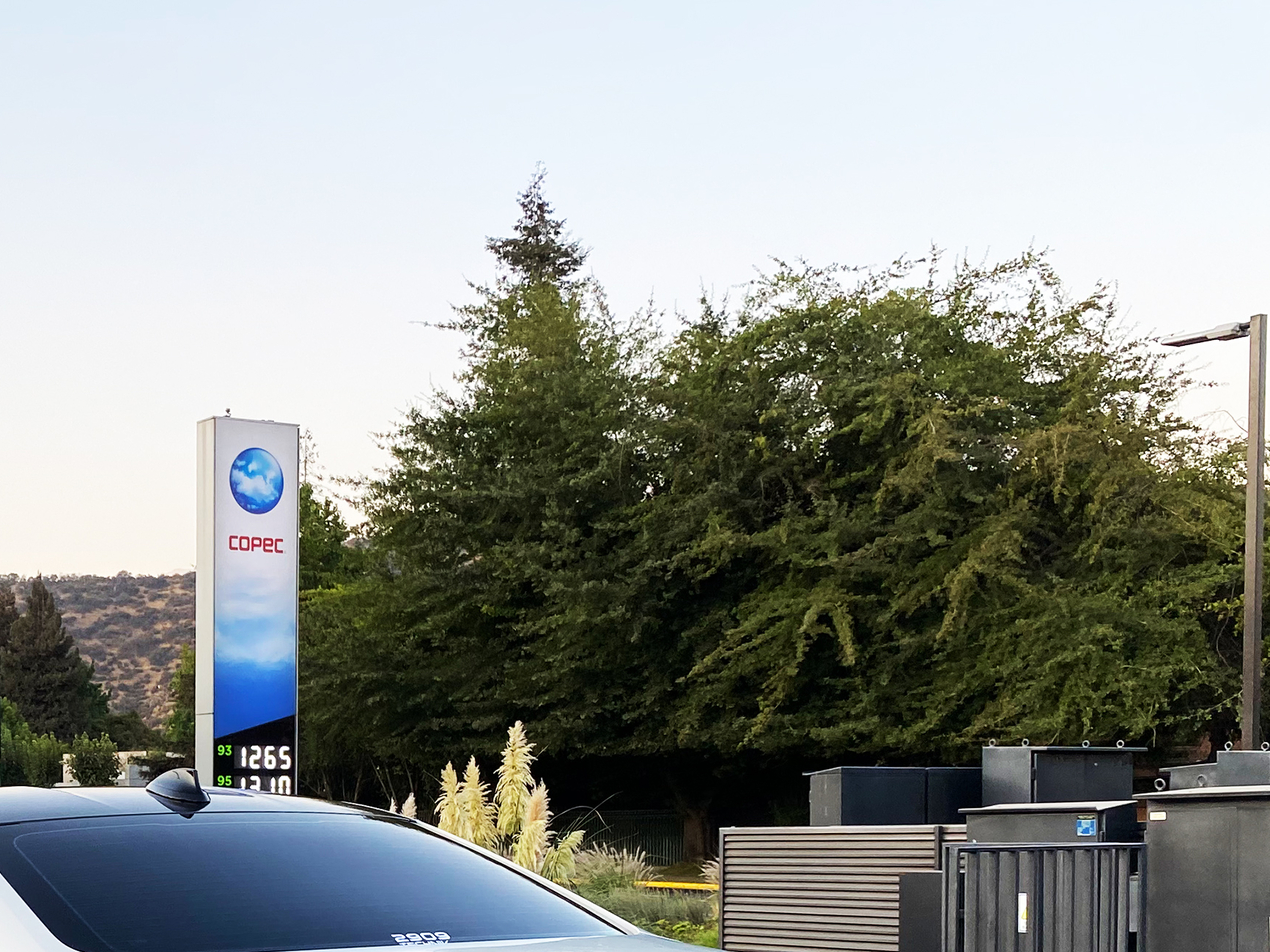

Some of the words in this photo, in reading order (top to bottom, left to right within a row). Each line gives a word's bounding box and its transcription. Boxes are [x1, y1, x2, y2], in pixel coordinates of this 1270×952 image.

[217, 745, 232, 756] 93
[241, 745, 291, 770] 1265
[217, 775, 232, 786] 95
[390, 932, 451, 943] 2909
